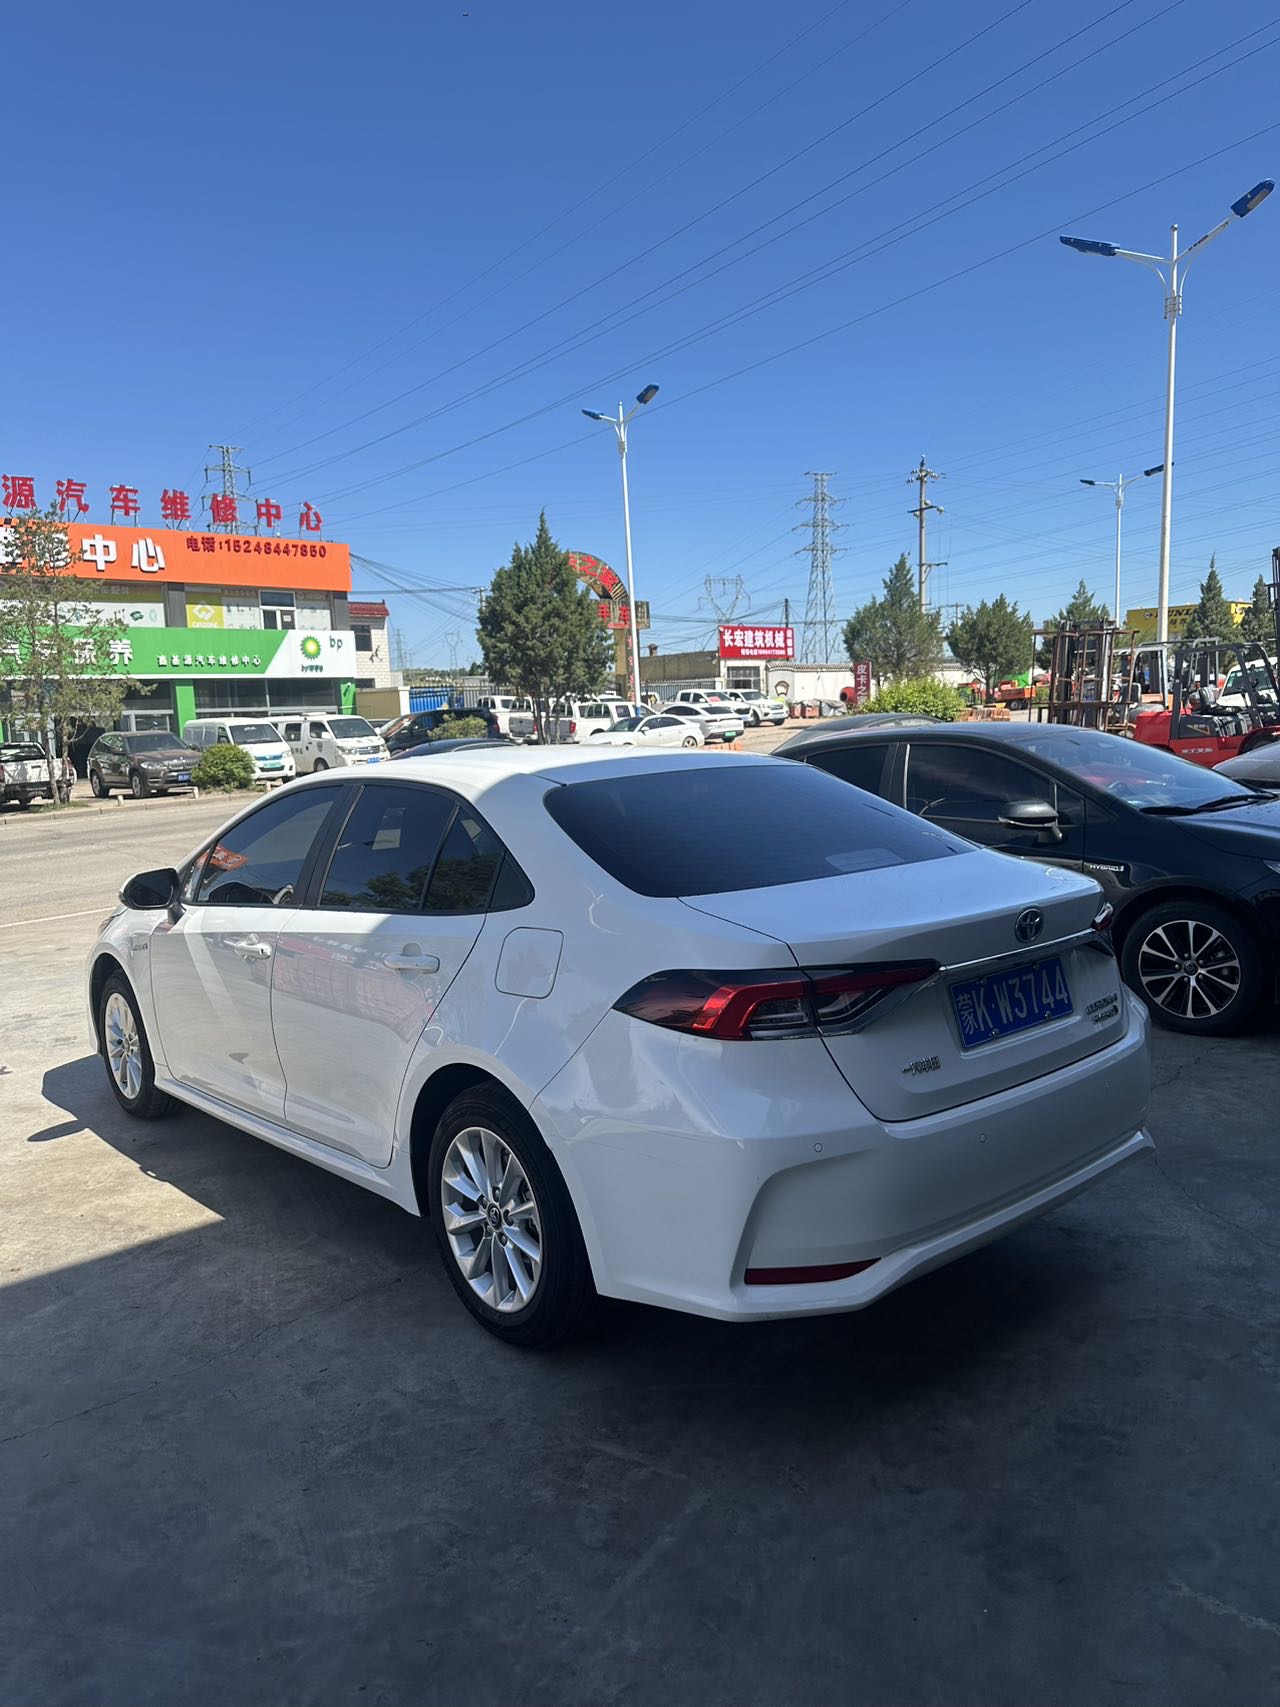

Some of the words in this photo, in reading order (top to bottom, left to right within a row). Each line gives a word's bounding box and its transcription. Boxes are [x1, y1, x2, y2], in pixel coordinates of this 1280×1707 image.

[2, 473, 322, 531] 源汽车维修中心
[329, 635, 343, 653] bp
[723, 629, 785, 648] 长宏建筑机械
[956, 965, 1069, 1035] 蒙K·W3744
